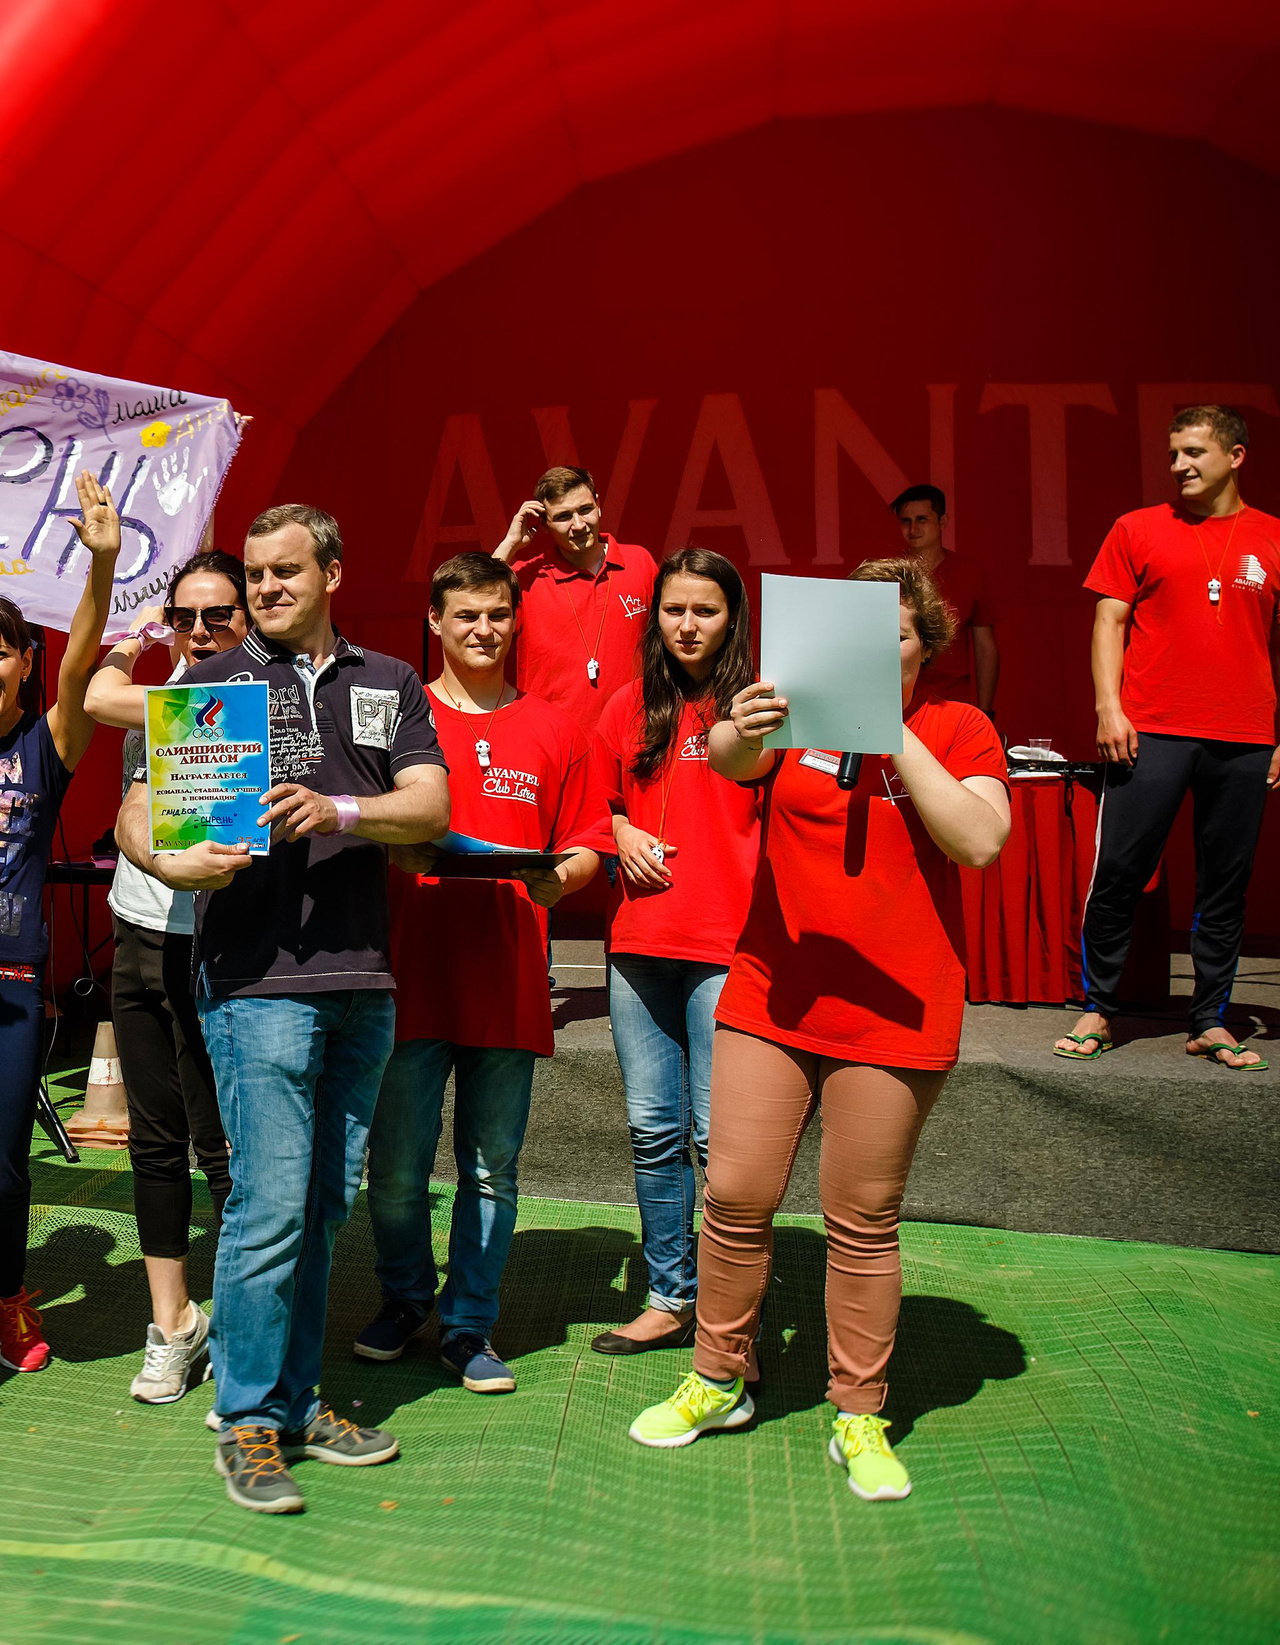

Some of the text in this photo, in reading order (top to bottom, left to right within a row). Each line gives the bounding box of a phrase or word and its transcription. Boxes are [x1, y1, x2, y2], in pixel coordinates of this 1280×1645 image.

[625, 594, 641, 606] Art
[268, 684, 300, 701] ord
[357, 698, 399, 730] PT
[155, 743, 262, 757] ОЛИМПИЙСКИЙ
[180, 754, 238, 765] ДИПЛОМ
[484, 767, 540, 786] AVANTEL
[483, 778, 536, 801] Club Istra
